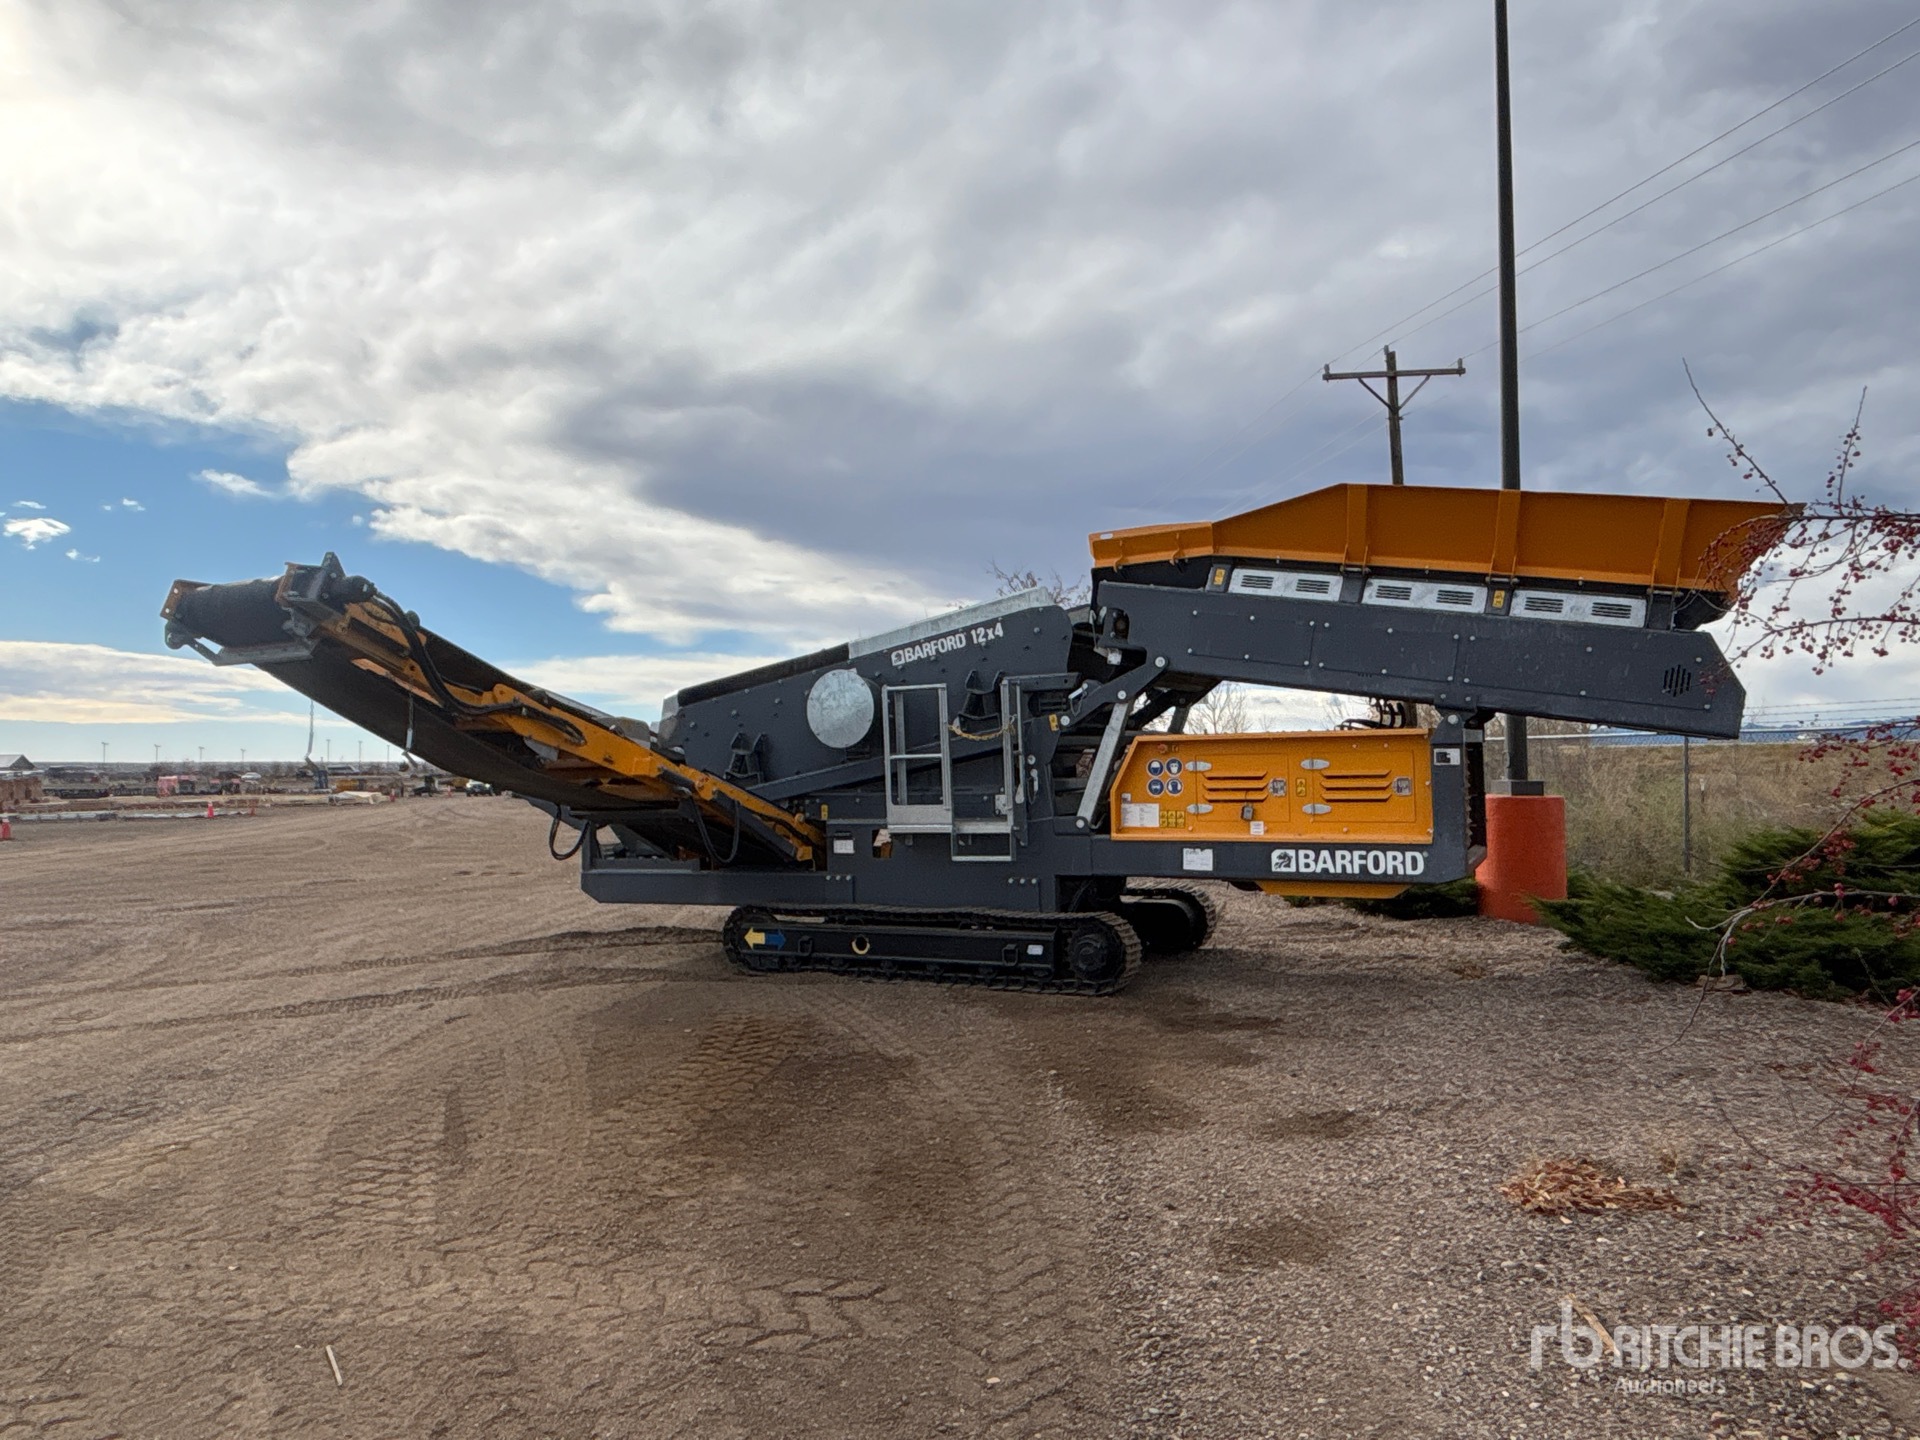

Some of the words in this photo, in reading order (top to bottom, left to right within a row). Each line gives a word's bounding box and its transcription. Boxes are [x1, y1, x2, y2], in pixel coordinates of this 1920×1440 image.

[904, 633, 966, 662] BARFORD
[971, 622, 1004, 644] 12x4
[1298, 849, 1425, 876] BARFORD
